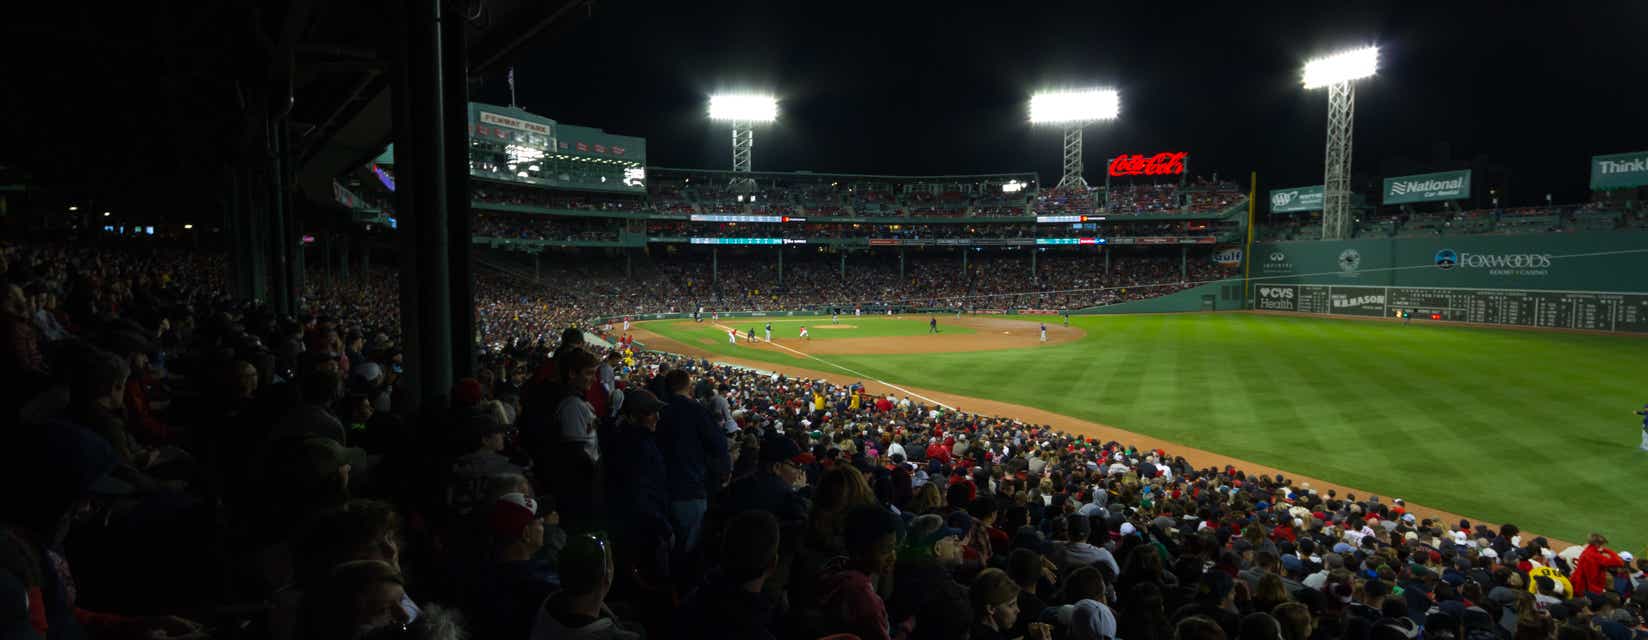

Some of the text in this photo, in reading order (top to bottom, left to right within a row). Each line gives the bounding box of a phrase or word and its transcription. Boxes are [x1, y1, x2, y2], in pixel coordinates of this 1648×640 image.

[1109, 151, 1189, 176] Coca-Cola
[1406, 176, 1463, 192] National
[1270, 287, 1294, 298] CVS
[1260, 298, 1293, 310] Health
